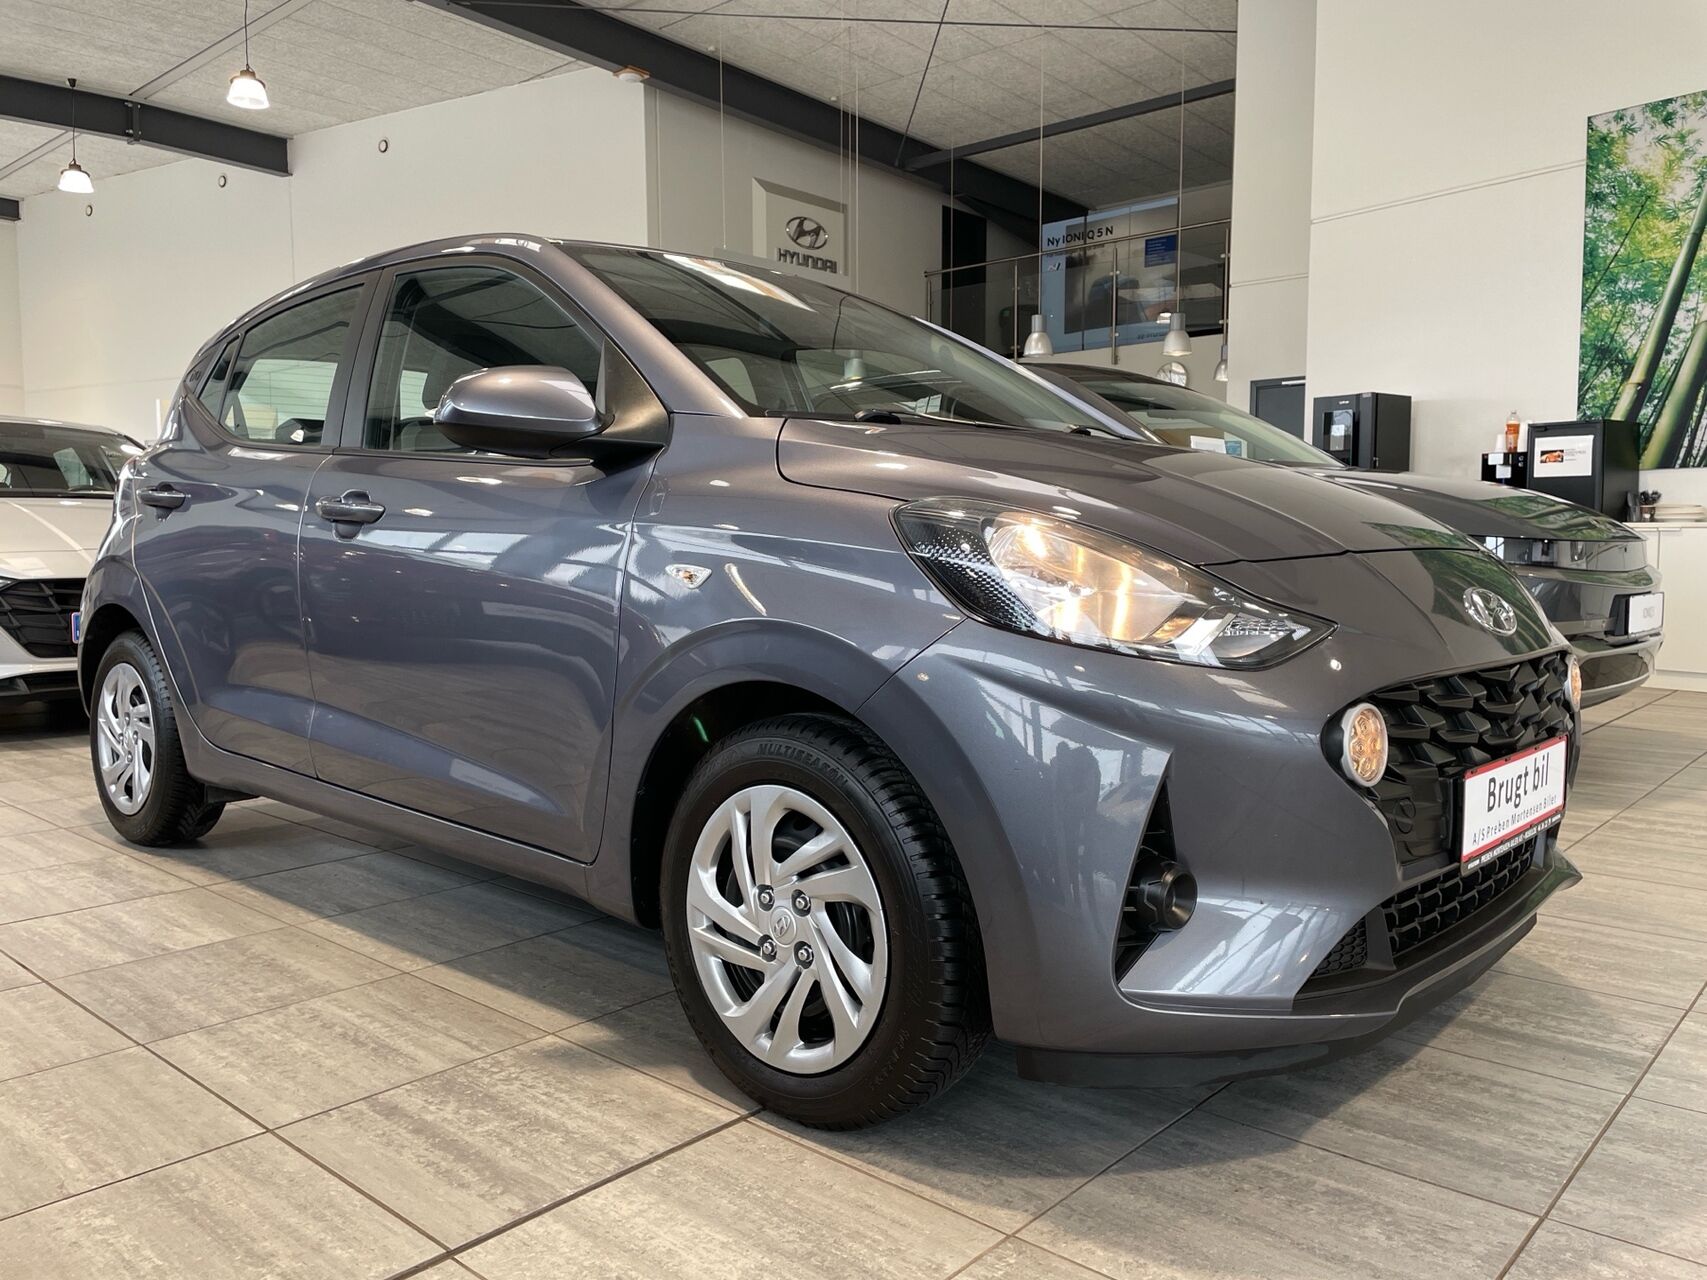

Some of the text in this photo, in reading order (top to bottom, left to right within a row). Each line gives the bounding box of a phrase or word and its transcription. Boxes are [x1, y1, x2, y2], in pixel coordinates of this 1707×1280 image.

[1047, 225, 1113, 247] Ny IONIQ 5 N
[777, 247, 837, 274] HYUNDAI
[1487, 751, 1550, 813] Brugt bil
[1472, 828, 1486, 846] A/S
[1486, 820, 1511, 836] Preben
[1511, 802, 1542, 826] Mortensen
